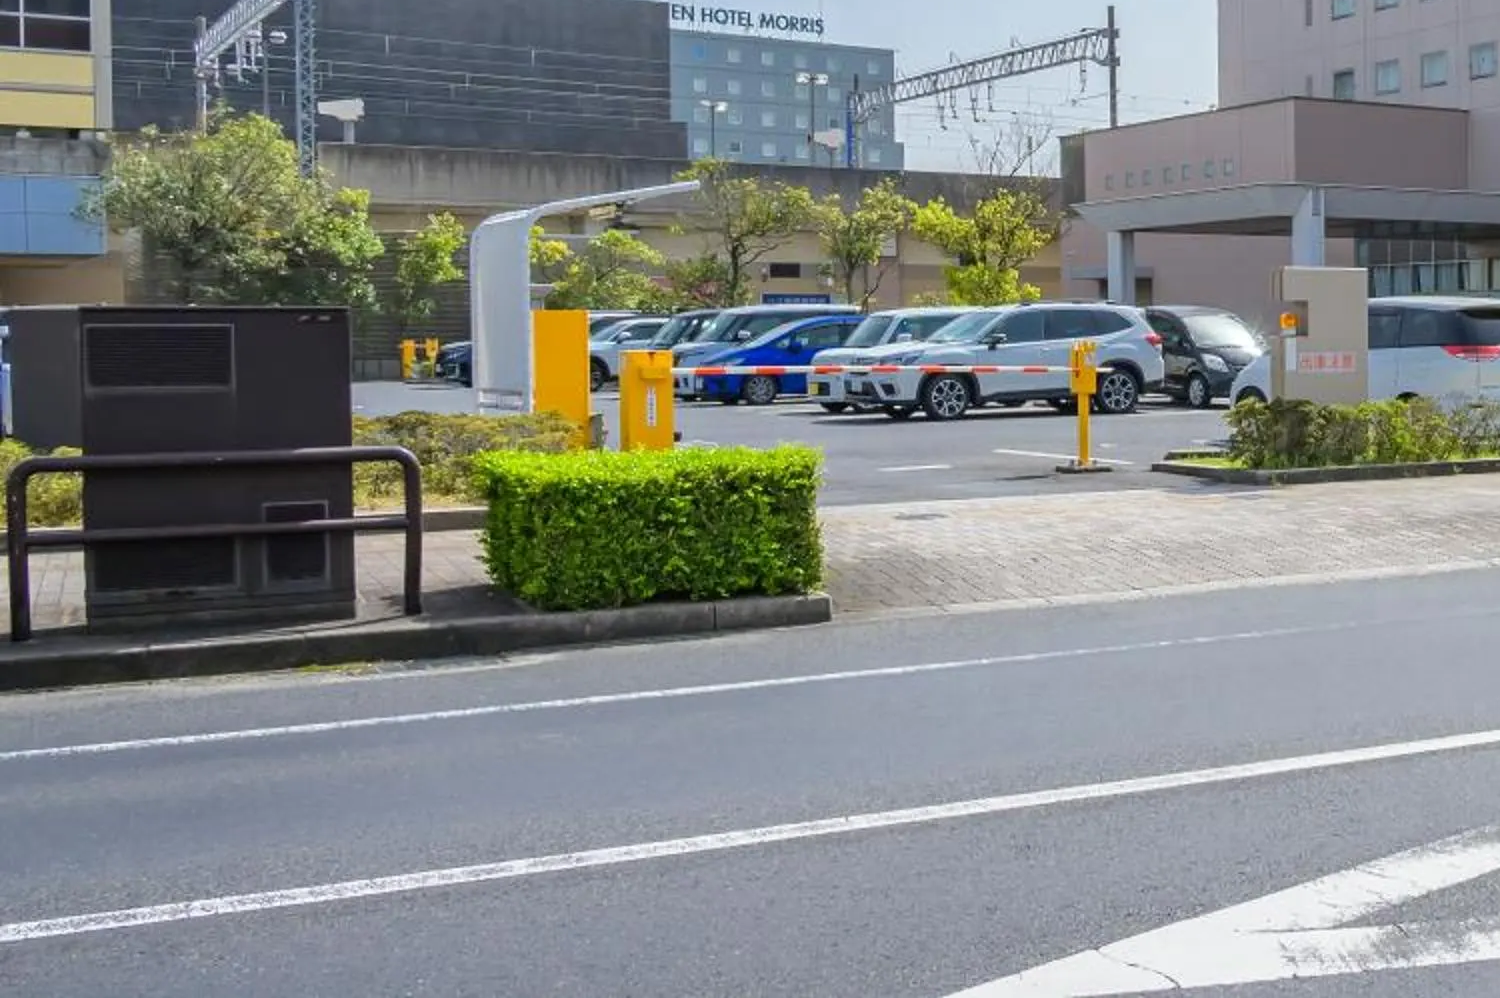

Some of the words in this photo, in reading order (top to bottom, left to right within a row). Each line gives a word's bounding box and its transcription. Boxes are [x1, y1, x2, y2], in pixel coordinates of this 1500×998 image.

[671, 3, 695, 22] EN
[701, 7, 754, 28] HOTEL
[759, 12, 825, 36] MORRIS
